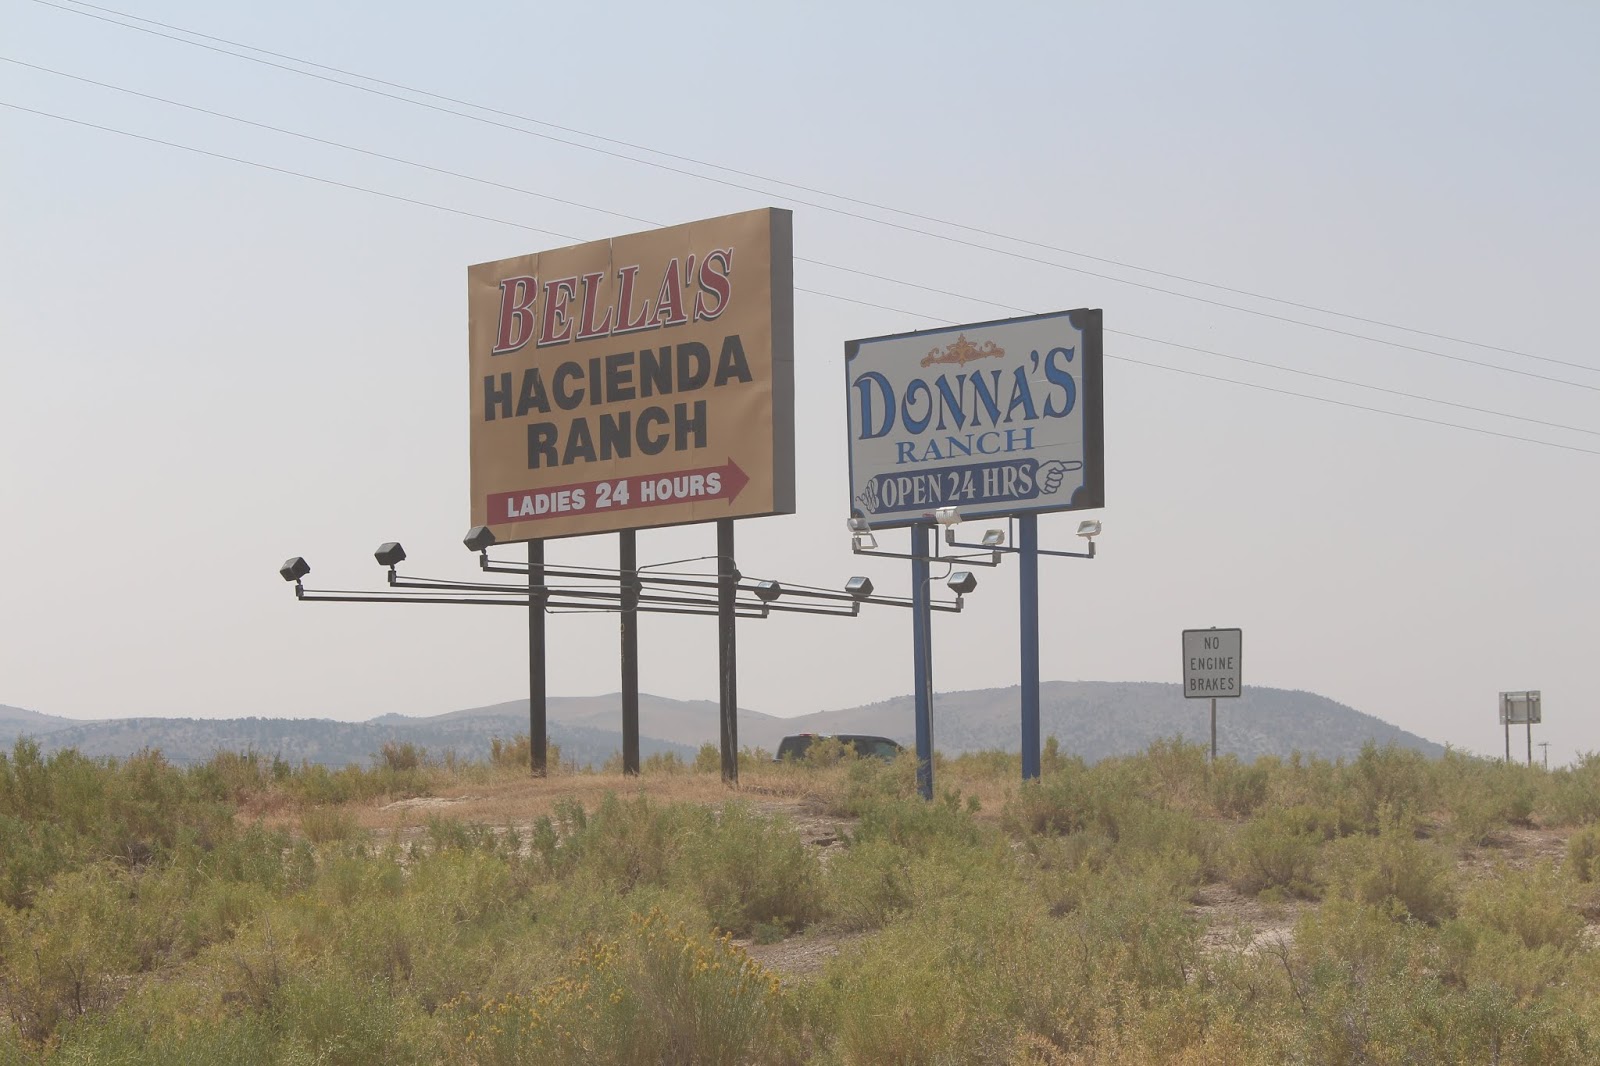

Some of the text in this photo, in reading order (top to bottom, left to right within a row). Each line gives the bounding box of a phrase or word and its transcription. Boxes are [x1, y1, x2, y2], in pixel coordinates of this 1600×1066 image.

[491, 247, 733, 355] BELLA'S
[483, 334, 753, 421] HACIENDA
[852, 346, 1077, 440] DONNA'S
[527, 400, 707, 469] RANCH
[895, 427, 1035, 465] RANCH
[507, 472, 722, 518] LADIES 24 HOURS
[881, 463, 1033, 508] OPEN 24 HRS
[1190, 656, 1234, 671] ENGINE
[1204, 636, 1220, 650] NO
[1190, 677, 1234, 691] BRAKES
